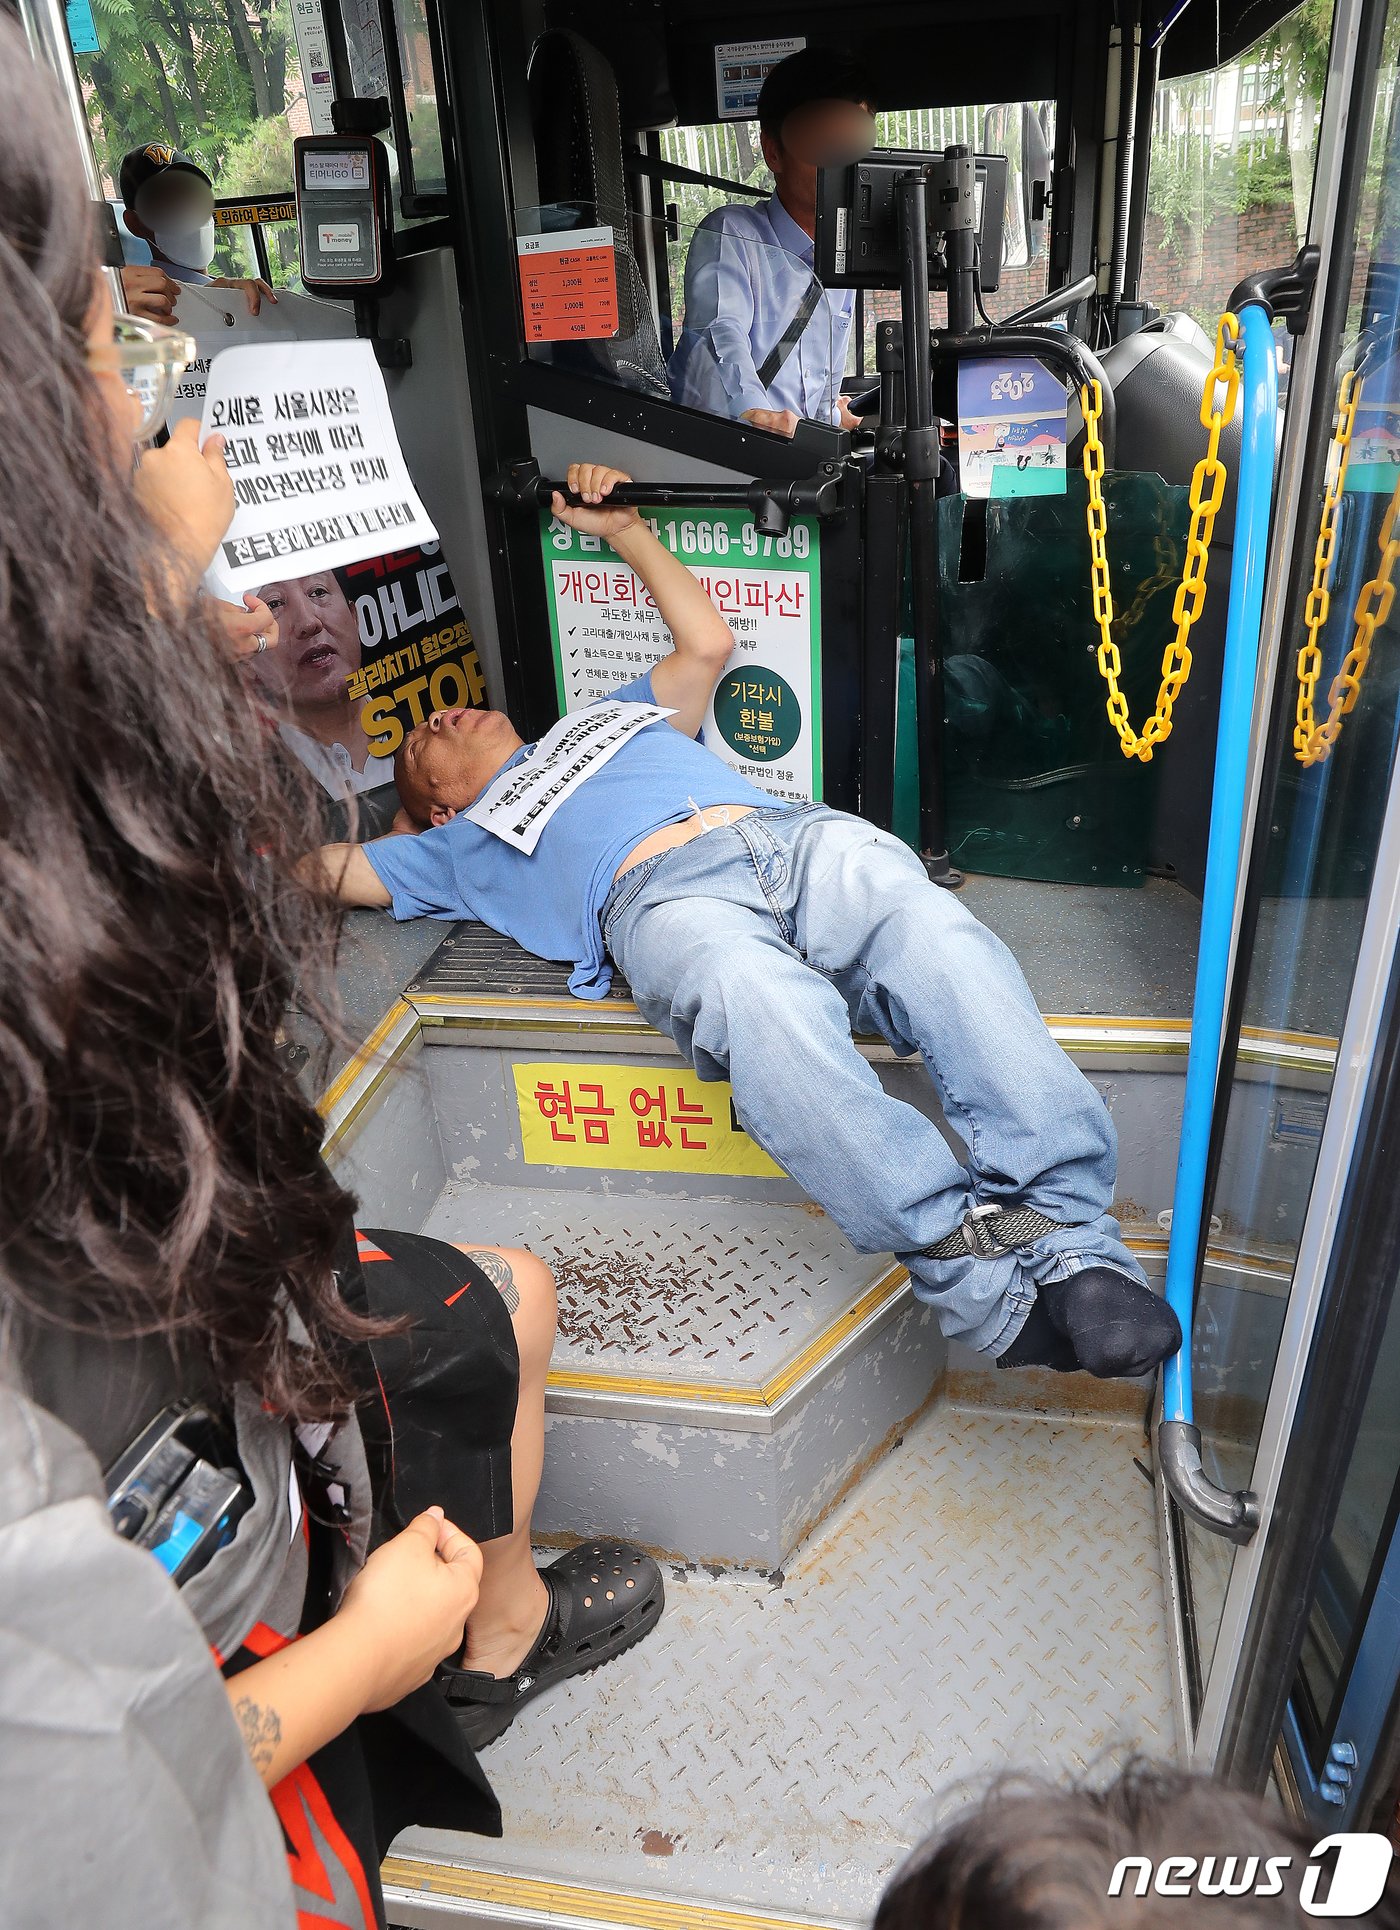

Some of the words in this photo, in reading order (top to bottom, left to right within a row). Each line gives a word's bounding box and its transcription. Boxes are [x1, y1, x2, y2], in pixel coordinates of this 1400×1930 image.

[310, 170, 349, 180] 티머니GO
[221, 208, 254, 224] 위하여
[562, 278, 582, 287] 1,300원
[564, 301, 584, 310] 1,000원
[571, 324, 586, 332] 450원
[991, 372, 1034, 400] 2023
[211, 396, 264, 429] 오세훈
[273, 387, 360, 421] 서울시장은
[265, 427, 325, 463] 원칙에
[328, 423, 366, 452] 따라
[234, 463, 347, 509] 애인권리보장
[601, 608, 631, 622] 과도한
[728, 616, 757, 631] 해방!!
[582, 627, 650, 643] 고리대출/개인사채
[652, 632, 661, 643] 등
[740, 640, 757, 651] 채무
[584, 647, 624, 660] 월소득으로
[626, 651, 642, 662] 빚을
[345, 642, 422, 701] 갈라치기
[586, 668, 610, 680] 연체로
[611, 671, 628, 682] 인한
[731, 681, 782, 707] 기각시
[740, 708, 775, 731] 환불
[739, 764, 773, 778] 법무법인
[776, 769, 795, 782] 정윤
[787, 791, 809, 801] 변호사
[534, 1080, 615, 1144] 현금
[629, 1085, 713, 1150] 없는
